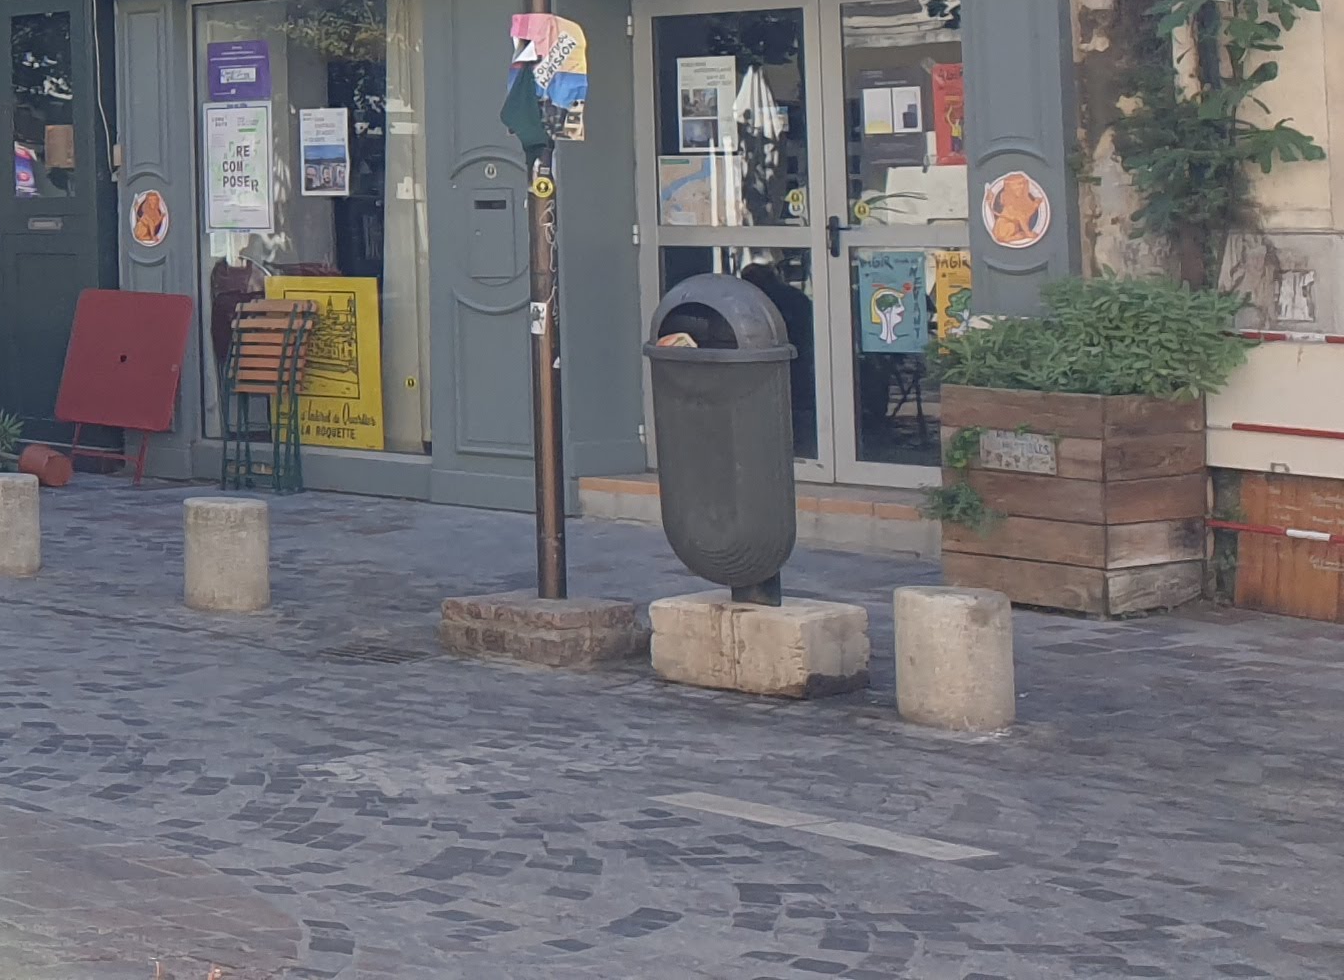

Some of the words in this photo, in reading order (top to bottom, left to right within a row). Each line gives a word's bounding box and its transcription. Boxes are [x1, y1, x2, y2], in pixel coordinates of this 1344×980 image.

[235, 145, 251, 158] RE
[222, 160, 244, 173] COM
[222, 175, 260, 193] POSER
[315, 425, 356, 440] ROQUETTE
